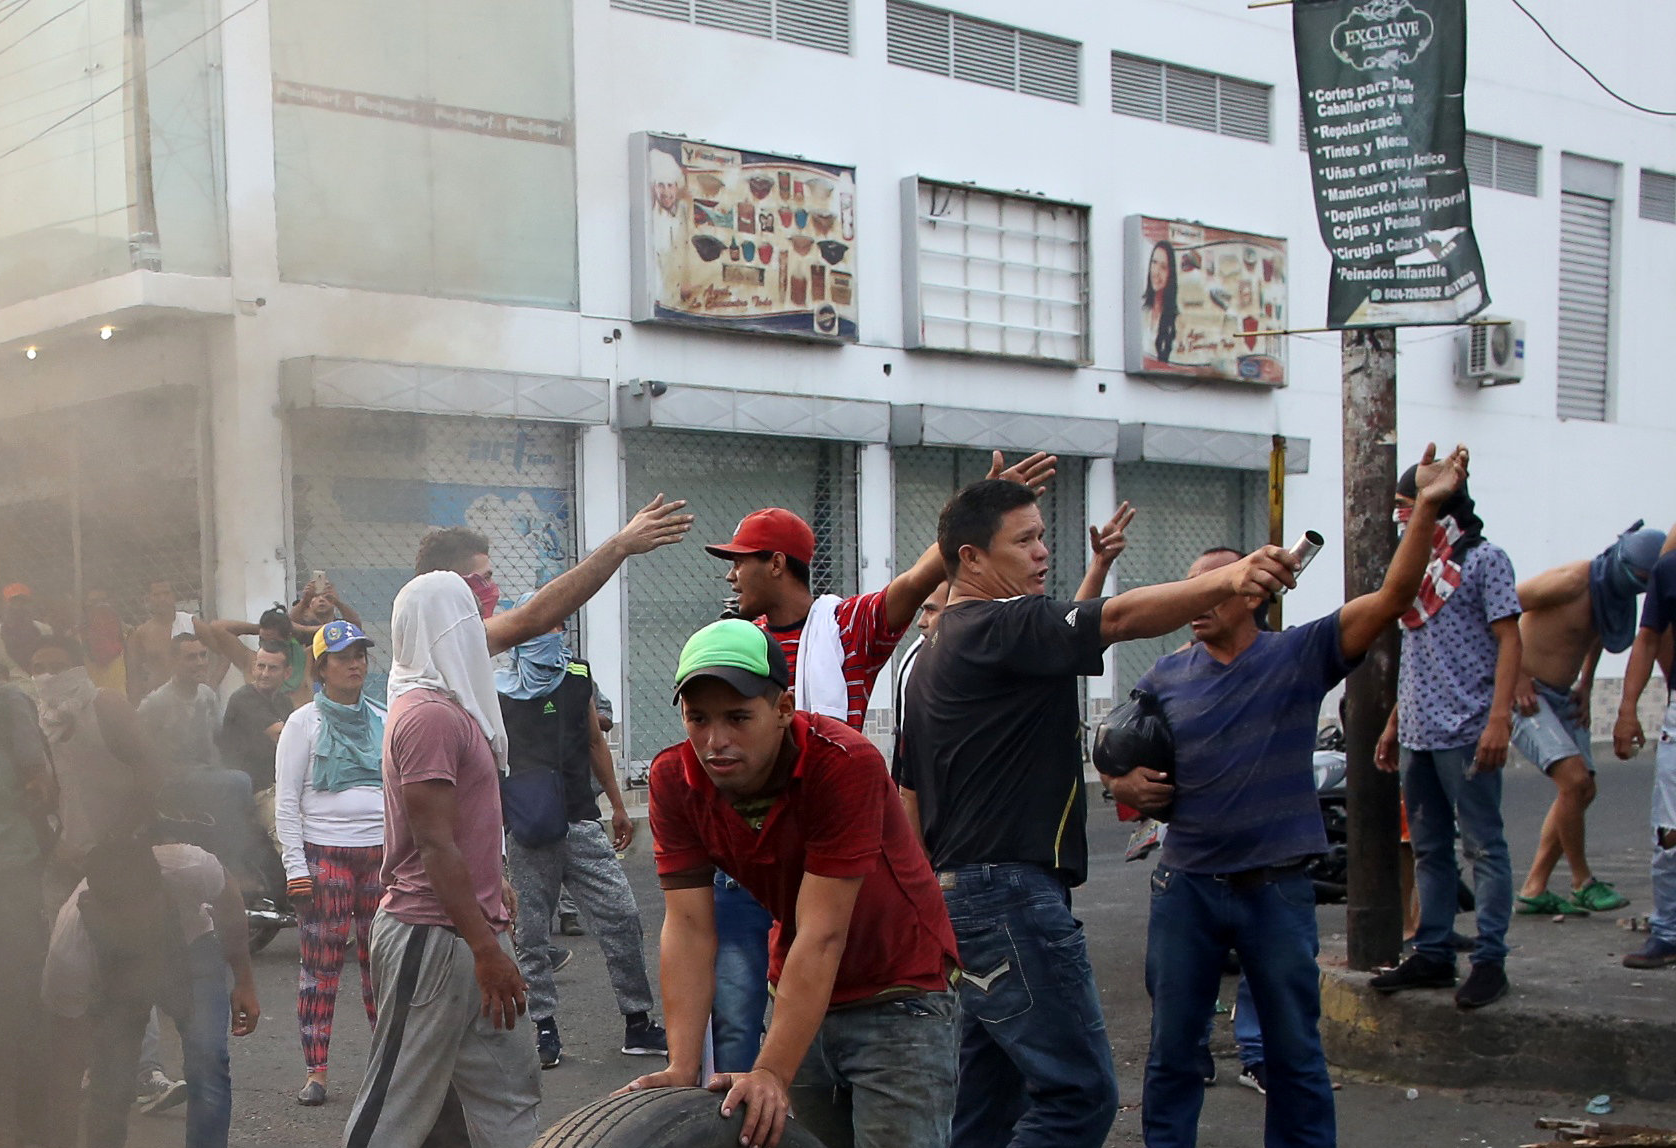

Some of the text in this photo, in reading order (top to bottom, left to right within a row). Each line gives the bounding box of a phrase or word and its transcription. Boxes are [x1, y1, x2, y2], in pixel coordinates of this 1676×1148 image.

[1315, 87, 1354, 103] Cortes
[1357, 80, 1389, 99] para
[1317, 96, 1385, 117] Caballeros
[1389, 95, 1397, 108] y
[1323, 145, 1360, 159] Tintes
[1363, 142, 1372, 157] y
[1326, 163, 1356, 181] Uñas
[1359, 161, 1377, 175] en
[1328, 182, 1388, 202] Manicure
[1390, 179, 1398, 193] y
[1330, 199, 1397, 224] Depilación
[1333, 223, 1369, 241] Cejas
[1373, 222, 1381, 236] y
[1337, 242, 1383, 260] Cirugia
[1340, 267, 1395, 281] Peinados
